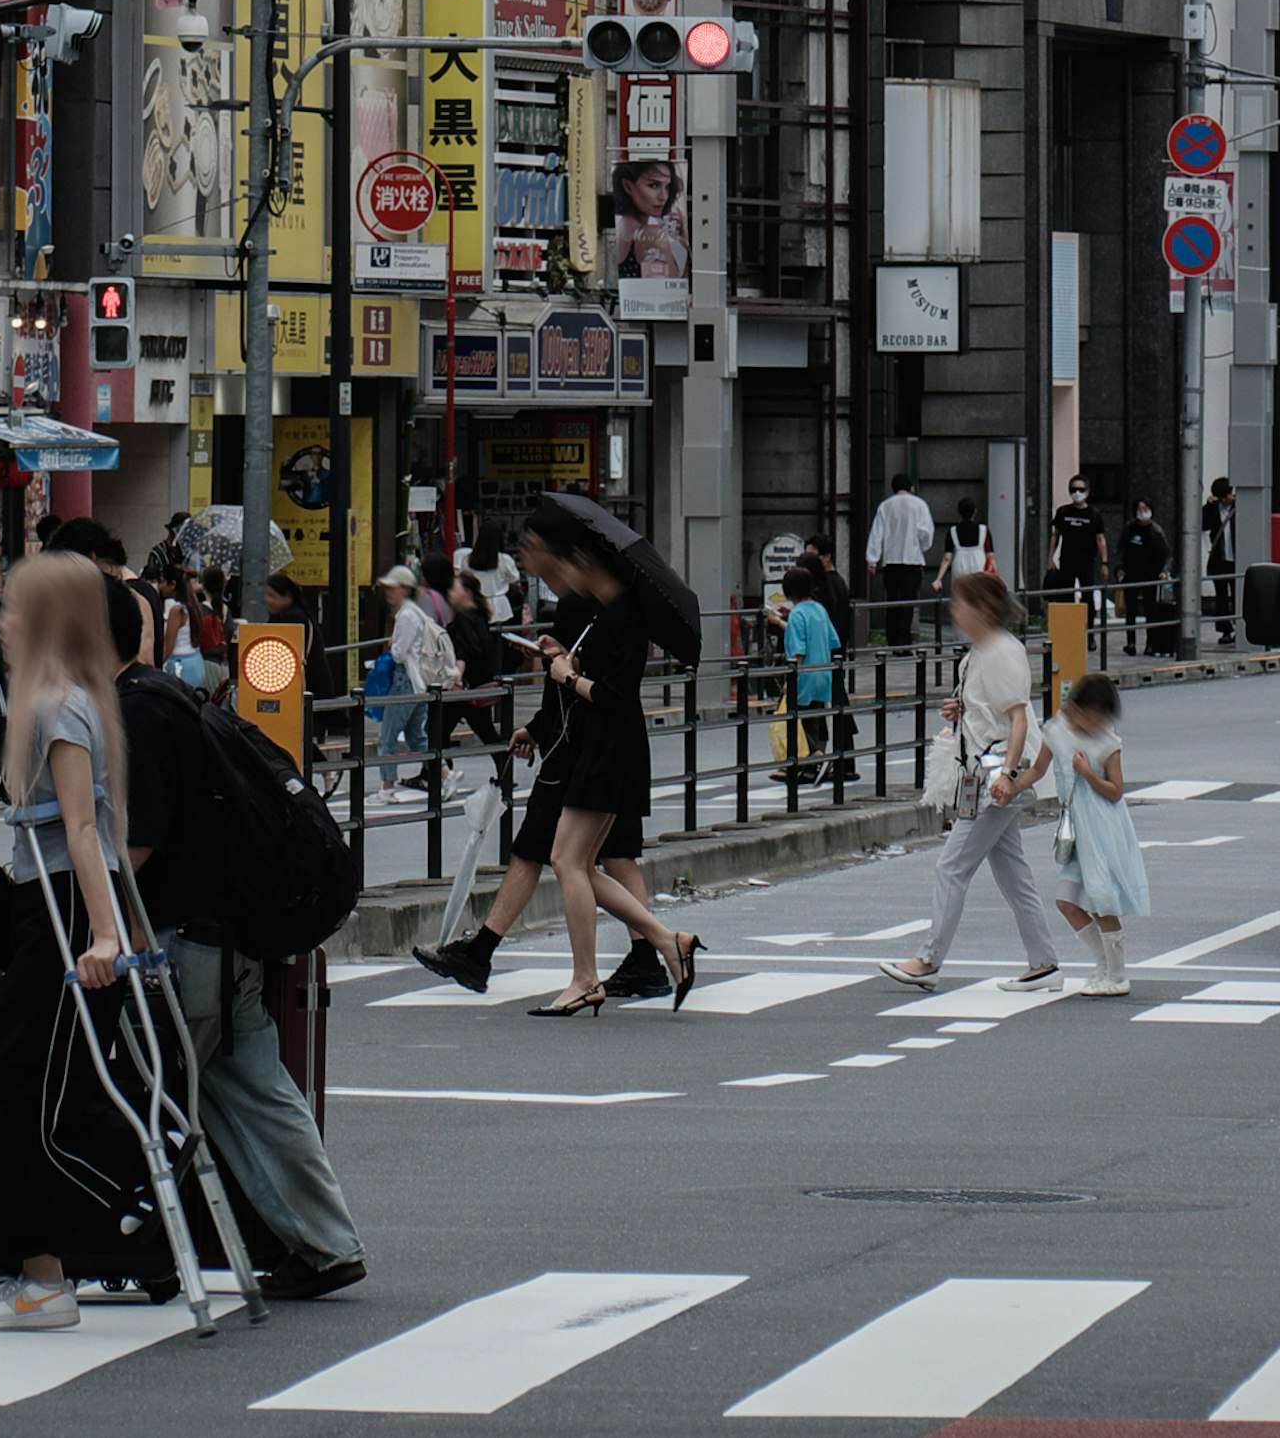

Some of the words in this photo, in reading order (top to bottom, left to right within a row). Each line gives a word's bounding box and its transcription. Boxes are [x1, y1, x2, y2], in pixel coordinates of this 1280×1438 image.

[375, 185, 429, 212] 消火栓
[455, 275, 481, 286] FREE
[907, 278, 949, 321] MUSIUM
[882, 333, 924, 347] RECORD
[926, 333, 948, 347] BAR
